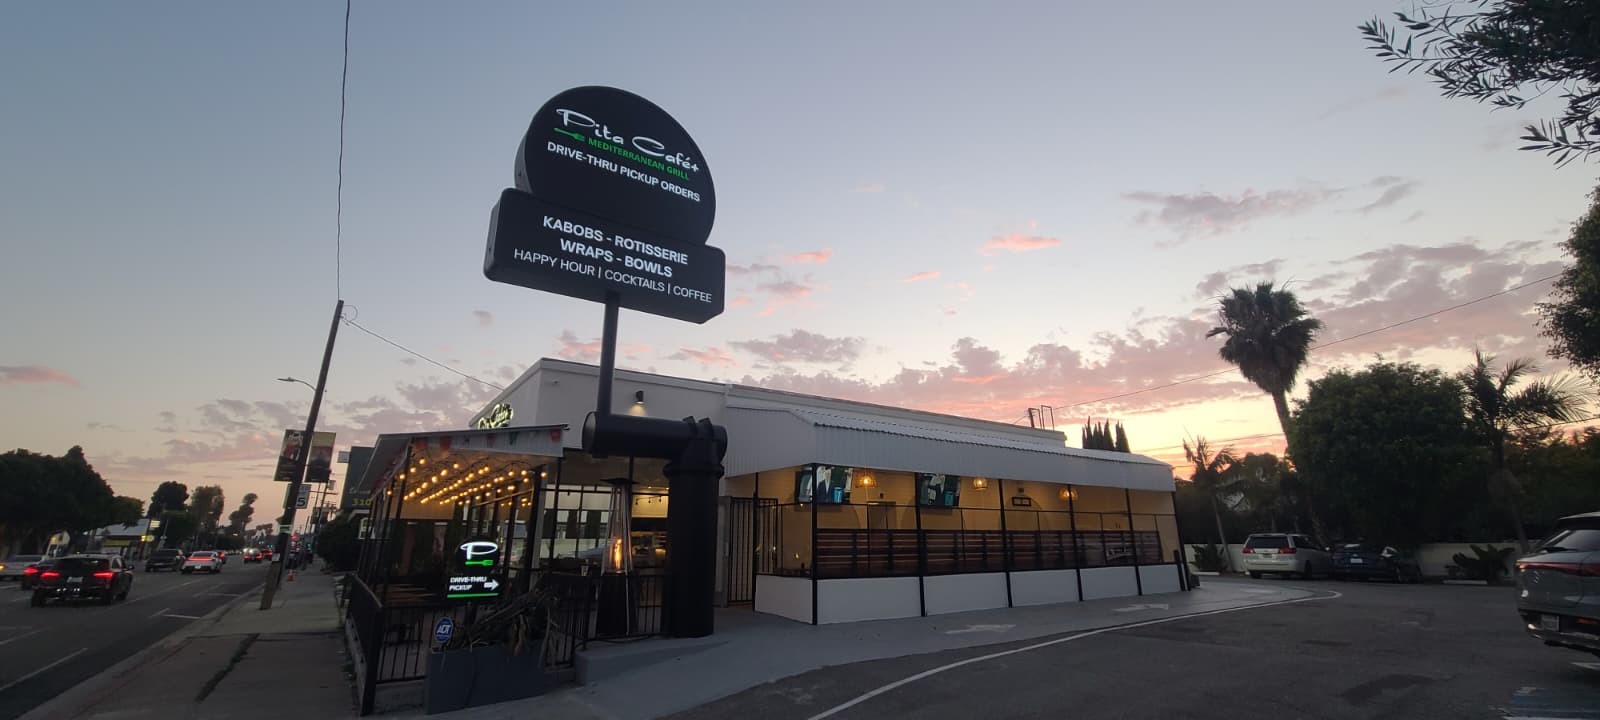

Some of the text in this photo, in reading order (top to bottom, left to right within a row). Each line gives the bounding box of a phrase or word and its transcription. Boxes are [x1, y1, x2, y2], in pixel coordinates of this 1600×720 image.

[556, 109, 624, 145] Pita
[547, 141, 701, 202] DRIVE-THRU PICKUP ORDERS
[588, 137, 689, 181] MEDITERRANEAN GRILL
[543, 215, 604, 242] KABOBS
[614, 235, 689, 265] ROTISSERIE
[560, 238, 614, 263] WRAPS
[624, 255, 673, 278] BOWLS
[513, 248, 557, 268] HAPPY
[560, 259, 595, 276] HOUR
[604, 269, 665, 292] COCKTAILS
[673, 285, 712, 303] COFFEE
[436, 624, 451, 634] ADT
